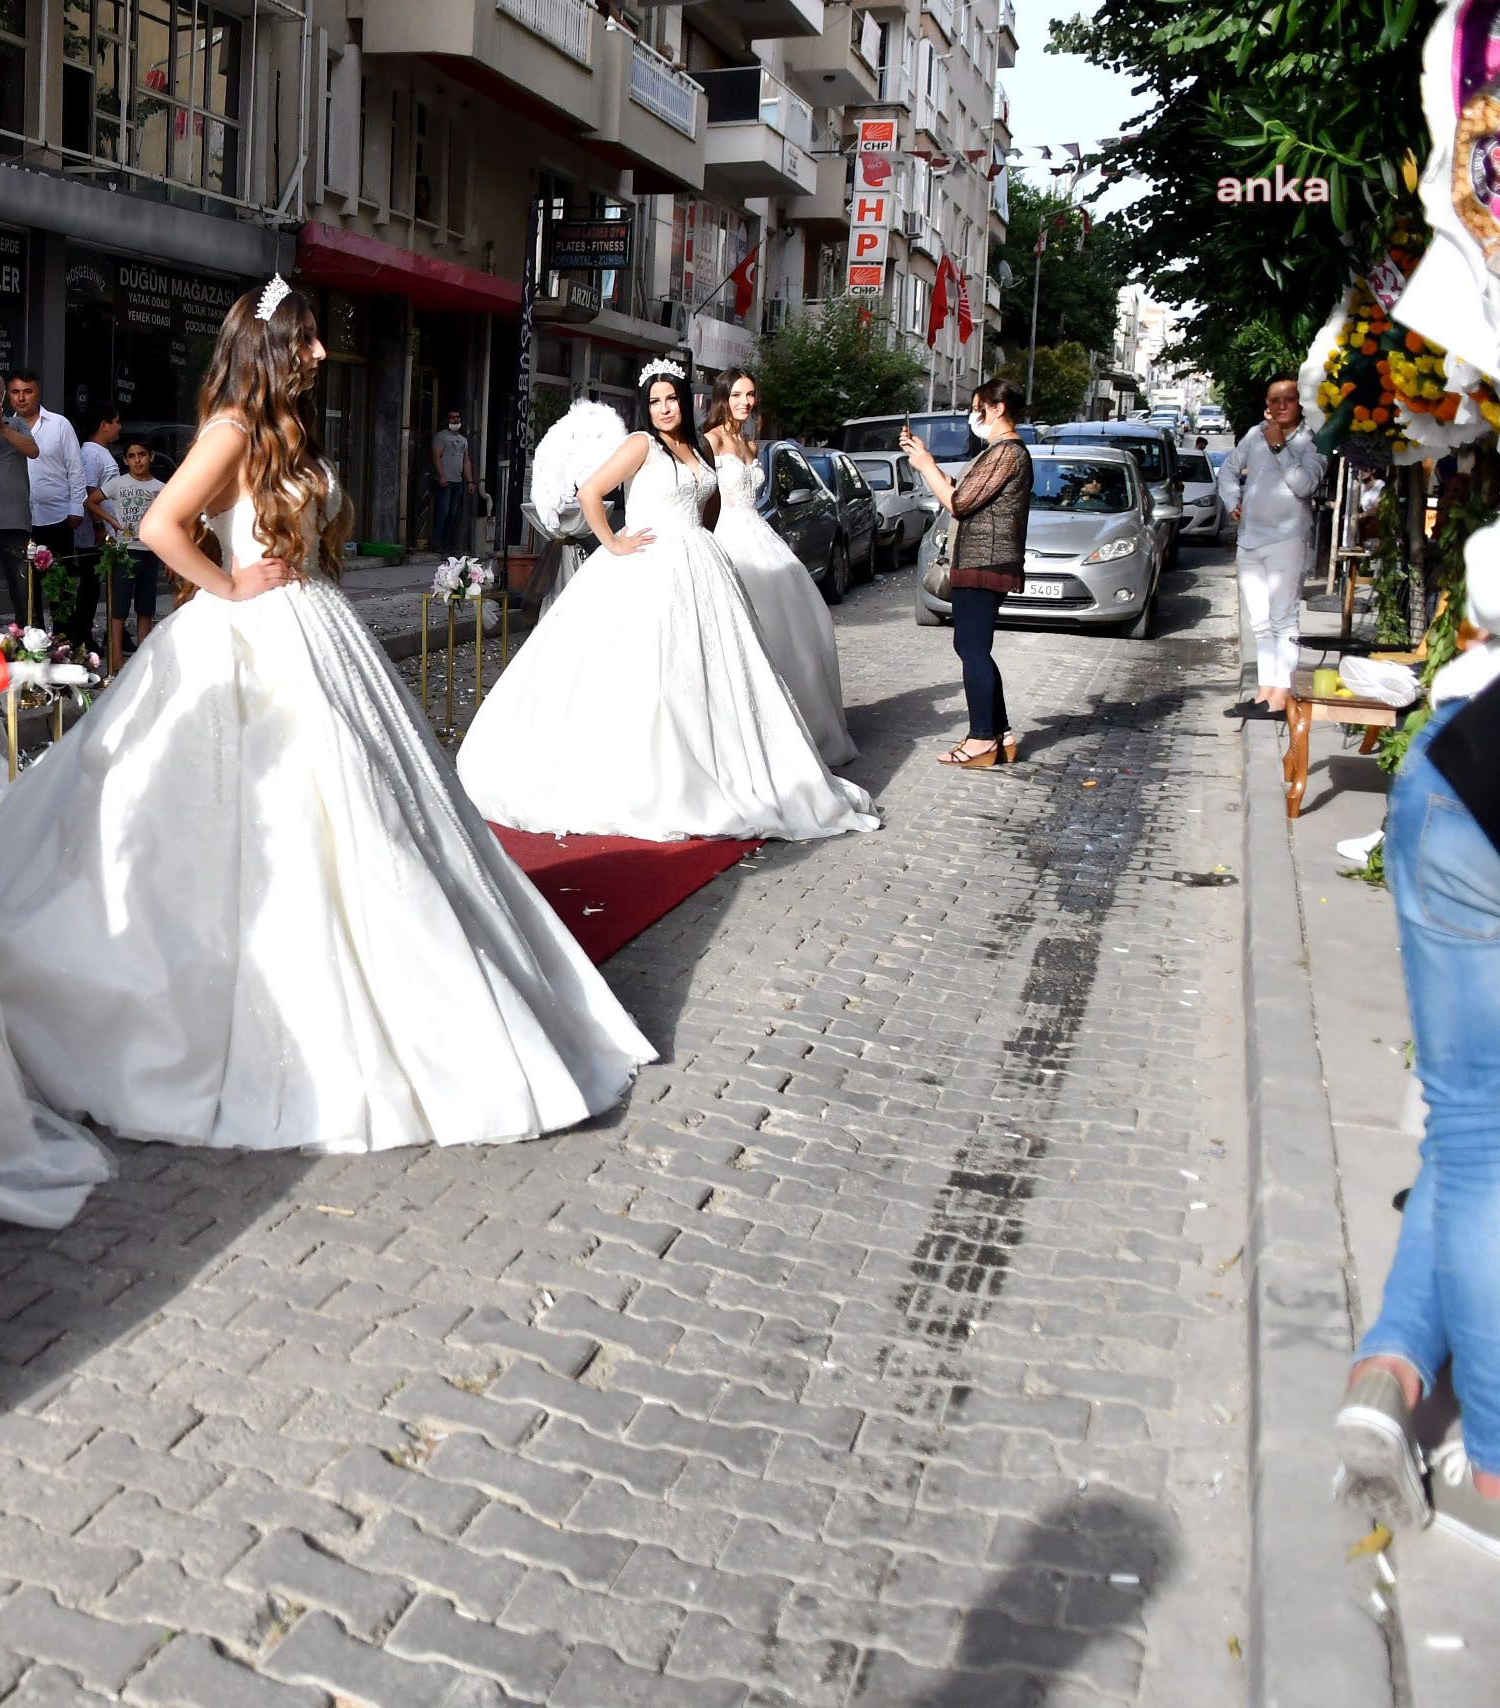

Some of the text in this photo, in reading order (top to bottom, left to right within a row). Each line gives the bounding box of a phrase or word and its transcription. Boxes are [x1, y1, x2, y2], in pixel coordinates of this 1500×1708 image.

[863, 142, 889, 151] CHP
[591, 240, 625, 252] FITNESS
[119, 265, 169, 295] DÜĞÜN
[851, 286, 877, 295] CHP
[128, 292, 150, 306] YATAK
[571, 286, 592, 309] ARZU
[127, 309, 171, 328] YEMEK ODASI
[206, 324, 222, 336] ODA
[120, 488, 134, 498] NEW
[129, 506, 140, 515] POP
[1030, 584, 1061, 596] 5405
